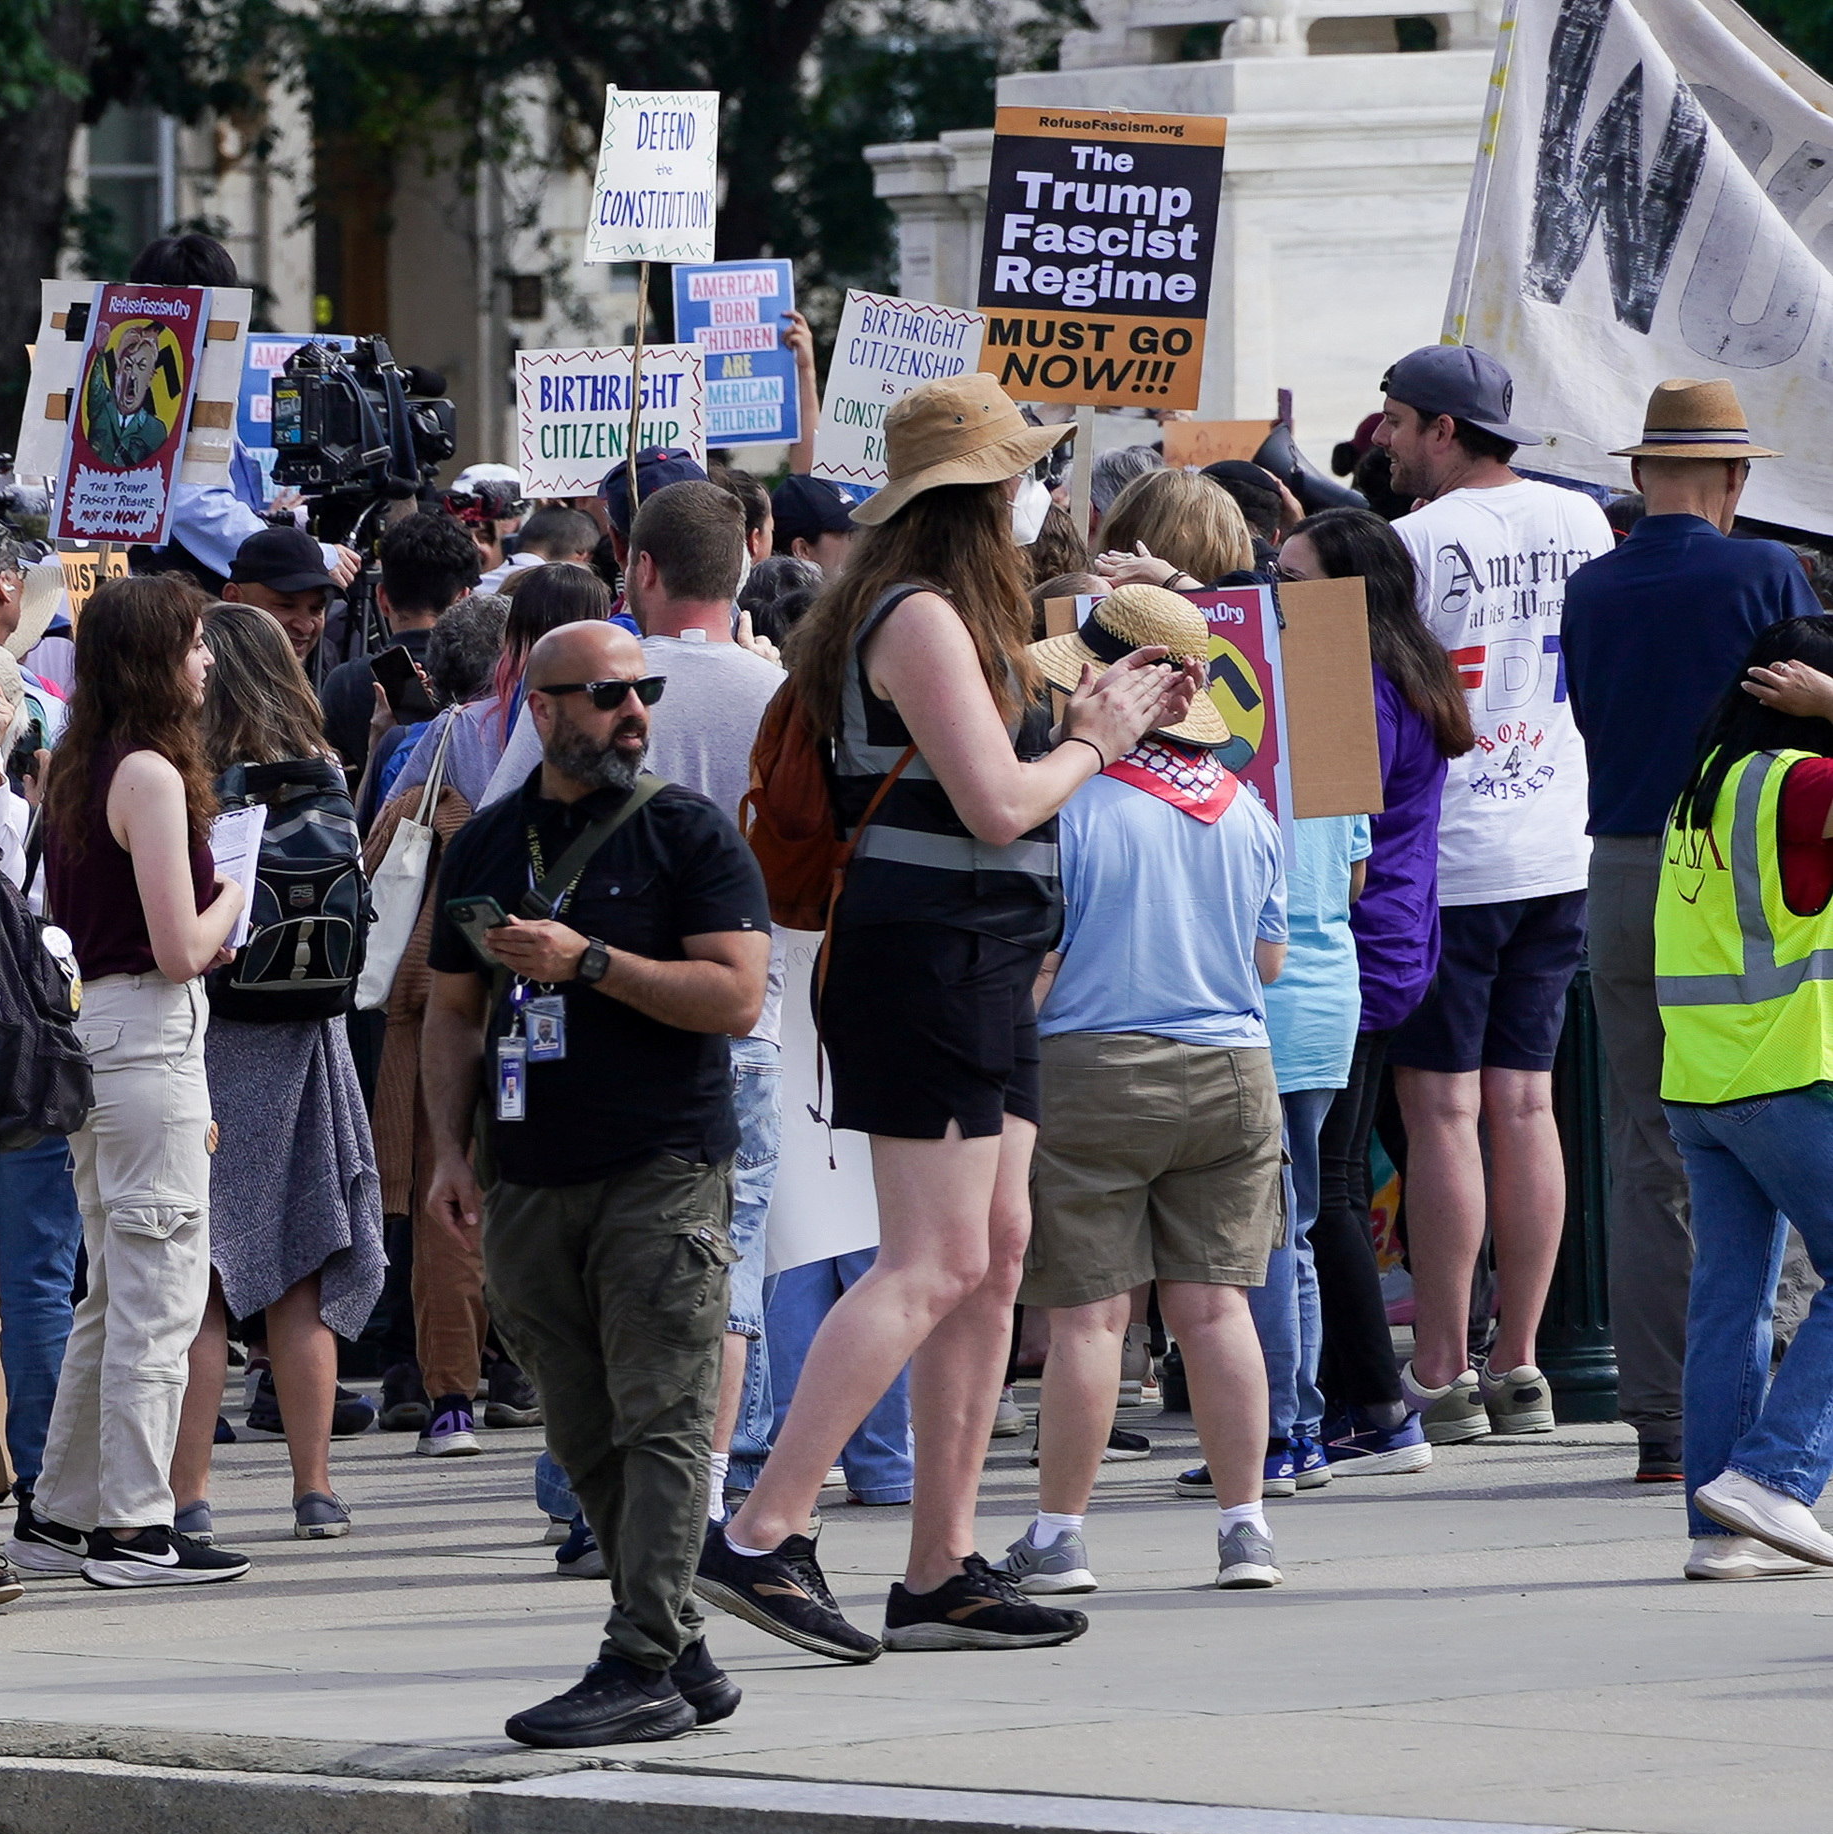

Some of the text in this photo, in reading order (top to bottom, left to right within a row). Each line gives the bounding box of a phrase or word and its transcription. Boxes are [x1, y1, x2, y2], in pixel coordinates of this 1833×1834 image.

[636, 111, 696, 150] DEFEND
[1038, 116, 1185, 138] RefuseFascism.org
[655, 162, 674, 176] the
[1071, 145, 1134, 173] The
[600, 189, 709, 229] CONSTITUTION
[1016, 170, 1192, 226] Trump
[1001, 213, 1199, 261] Fascist
[692, 273, 774, 298] AMERICAN
[993, 255, 1196, 307] Regime
[714, 301, 756, 323] BORN
[861, 306, 968, 350] BIRTHRIGHT
[699, 327, 772, 351] CHILDREN
[987, 317, 1193, 357] MUST GO
[722, 355, 753, 378] ARE
[849, 338, 964, 380] CITIZENSHIP
[1000, 352, 1177, 395] NOW!!!
[540, 373, 684, 413] BIRTHRIGHT
[706, 380, 779, 405] MERICAN
[541, 421, 679, 459] CITIZENHIP
[1507, 589, 1565, 629] Wors
